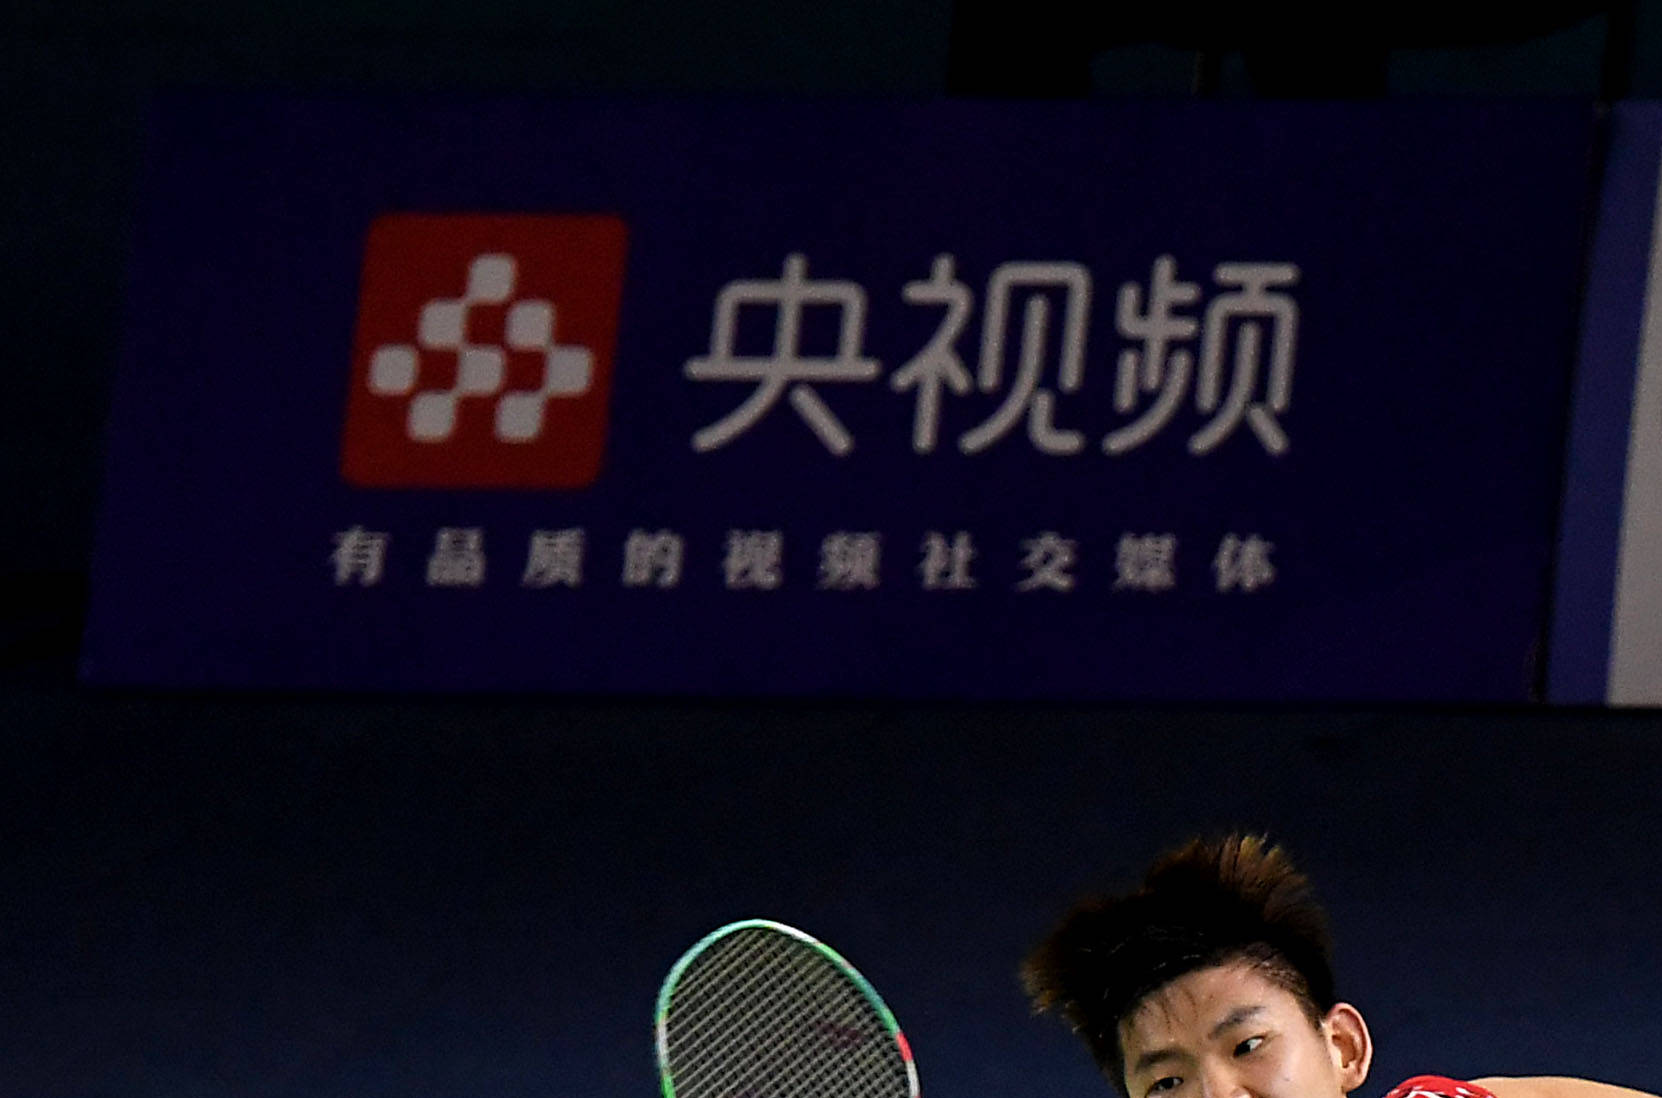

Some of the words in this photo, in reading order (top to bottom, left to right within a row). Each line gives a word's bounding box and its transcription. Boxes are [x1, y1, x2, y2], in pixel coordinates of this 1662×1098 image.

[684, 253, 1300, 455] 央视频
[333, 526, 1277, 592] 有品质的视频社交媒体
